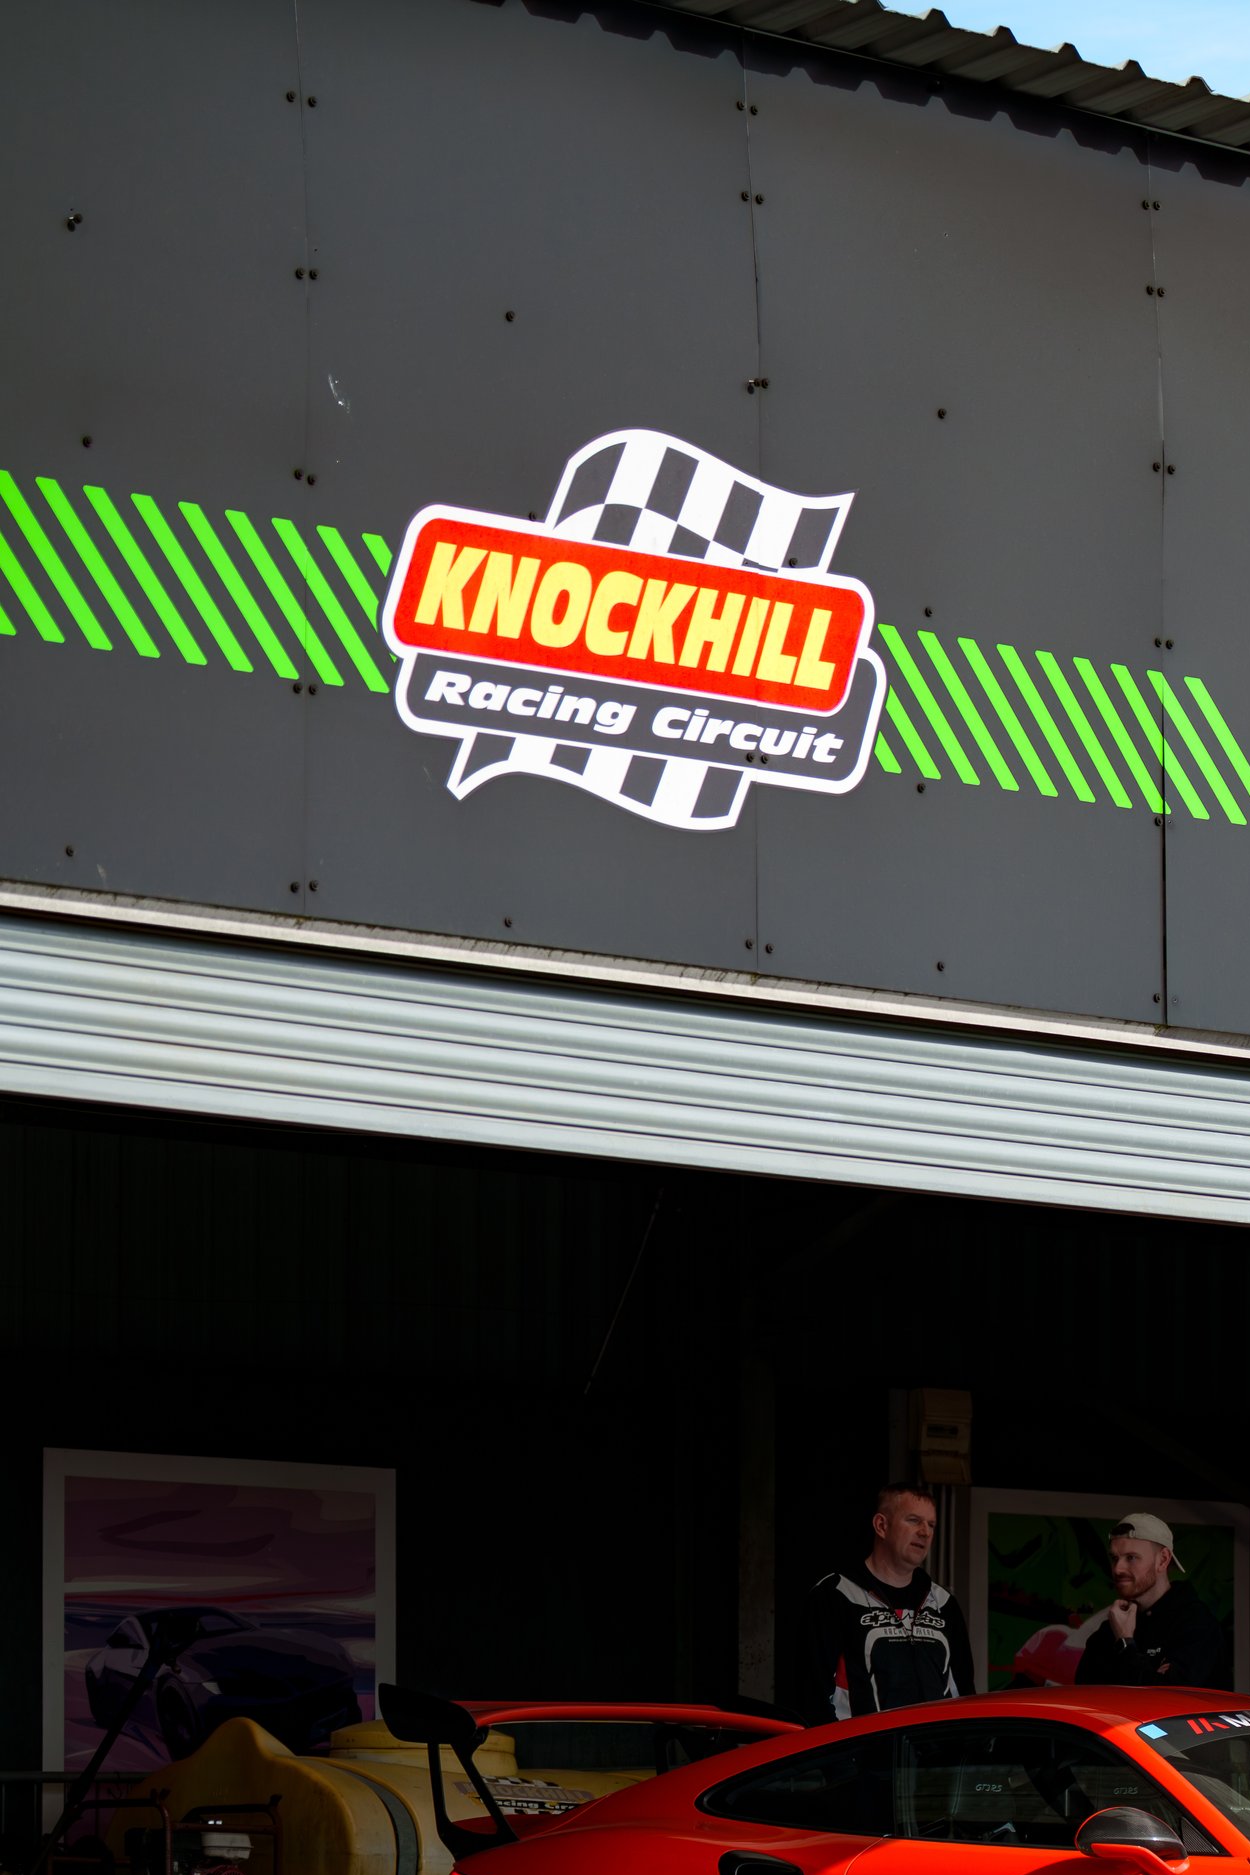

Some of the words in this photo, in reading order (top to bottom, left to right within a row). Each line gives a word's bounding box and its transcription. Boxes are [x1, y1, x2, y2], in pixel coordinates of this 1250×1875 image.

[414, 541, 837, 691] KNOCKHILL
[424, 670, 637, 736] Racing
[651, 706, 845, 764] Circuit
